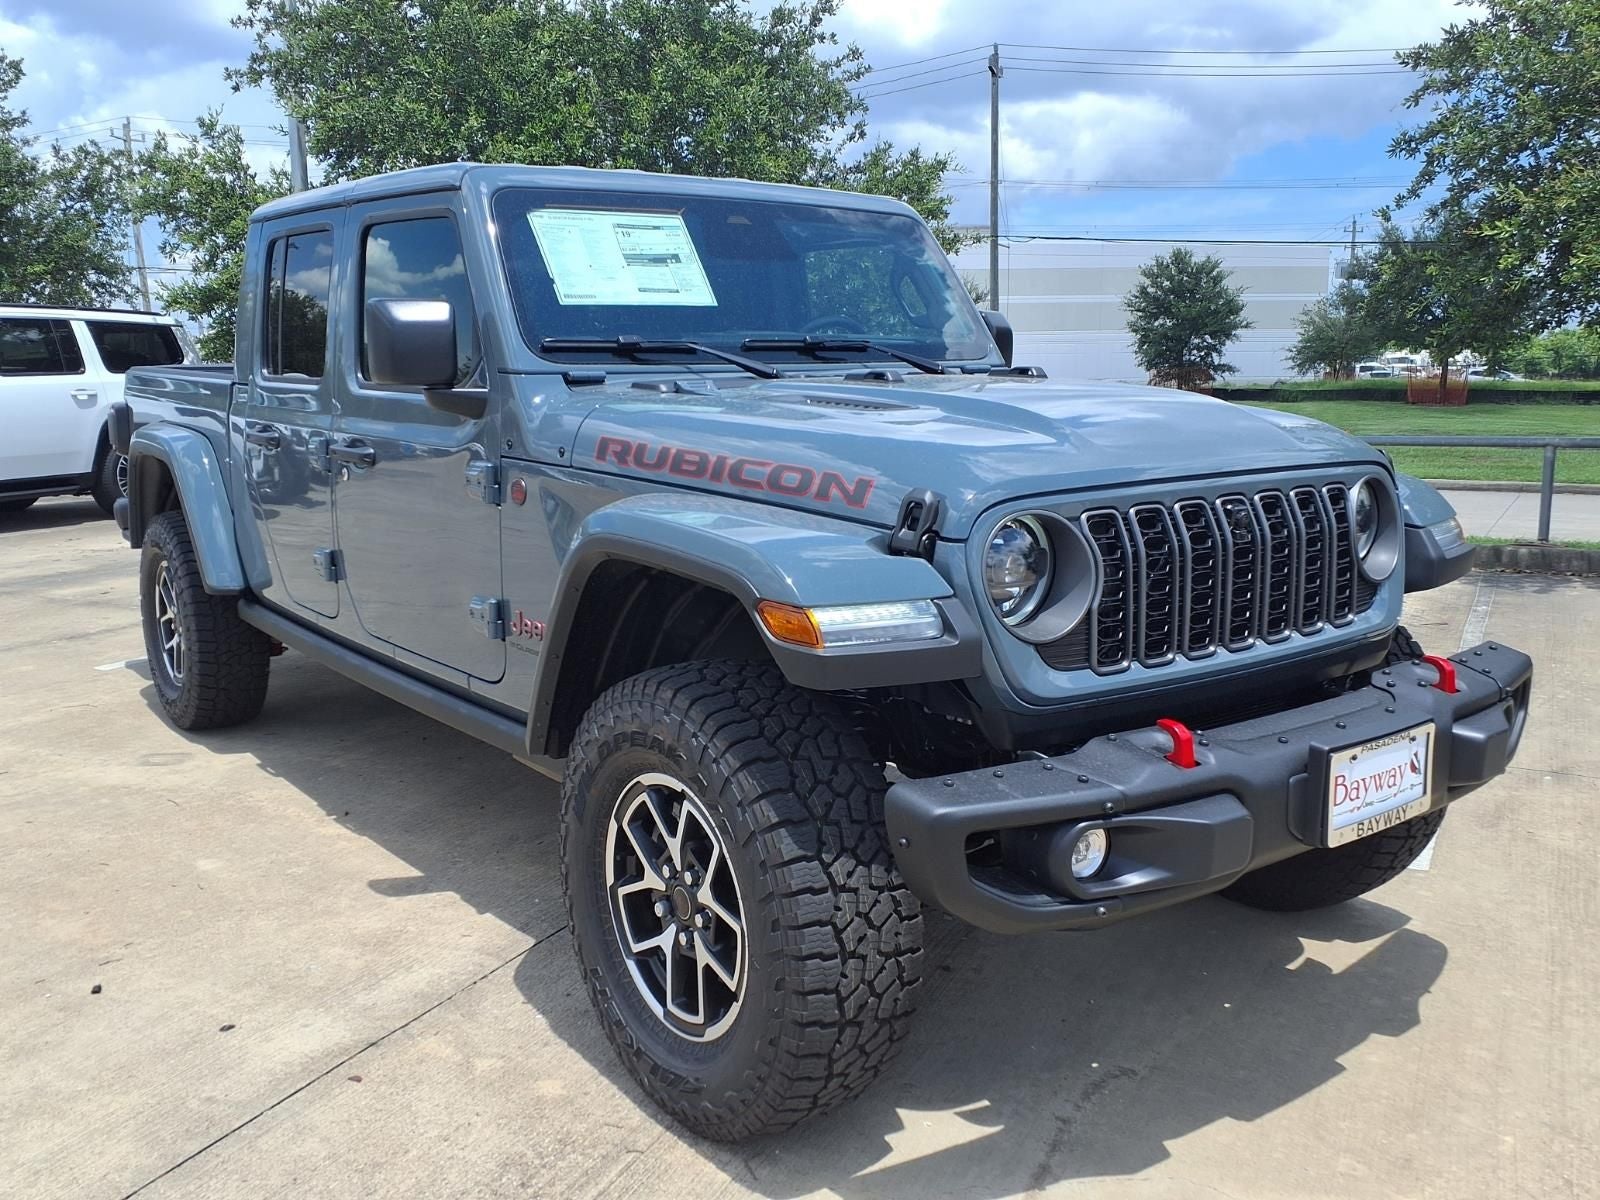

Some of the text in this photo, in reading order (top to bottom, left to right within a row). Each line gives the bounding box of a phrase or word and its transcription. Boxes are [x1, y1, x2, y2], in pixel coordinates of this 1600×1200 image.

[595, 435, 876, 509] RUBICON
[1361, 731, 1411, 753] PASADENA
[1334, 763, 1408, 806] Bayway
[1356, 805, 1409, 837] BAYWAY
